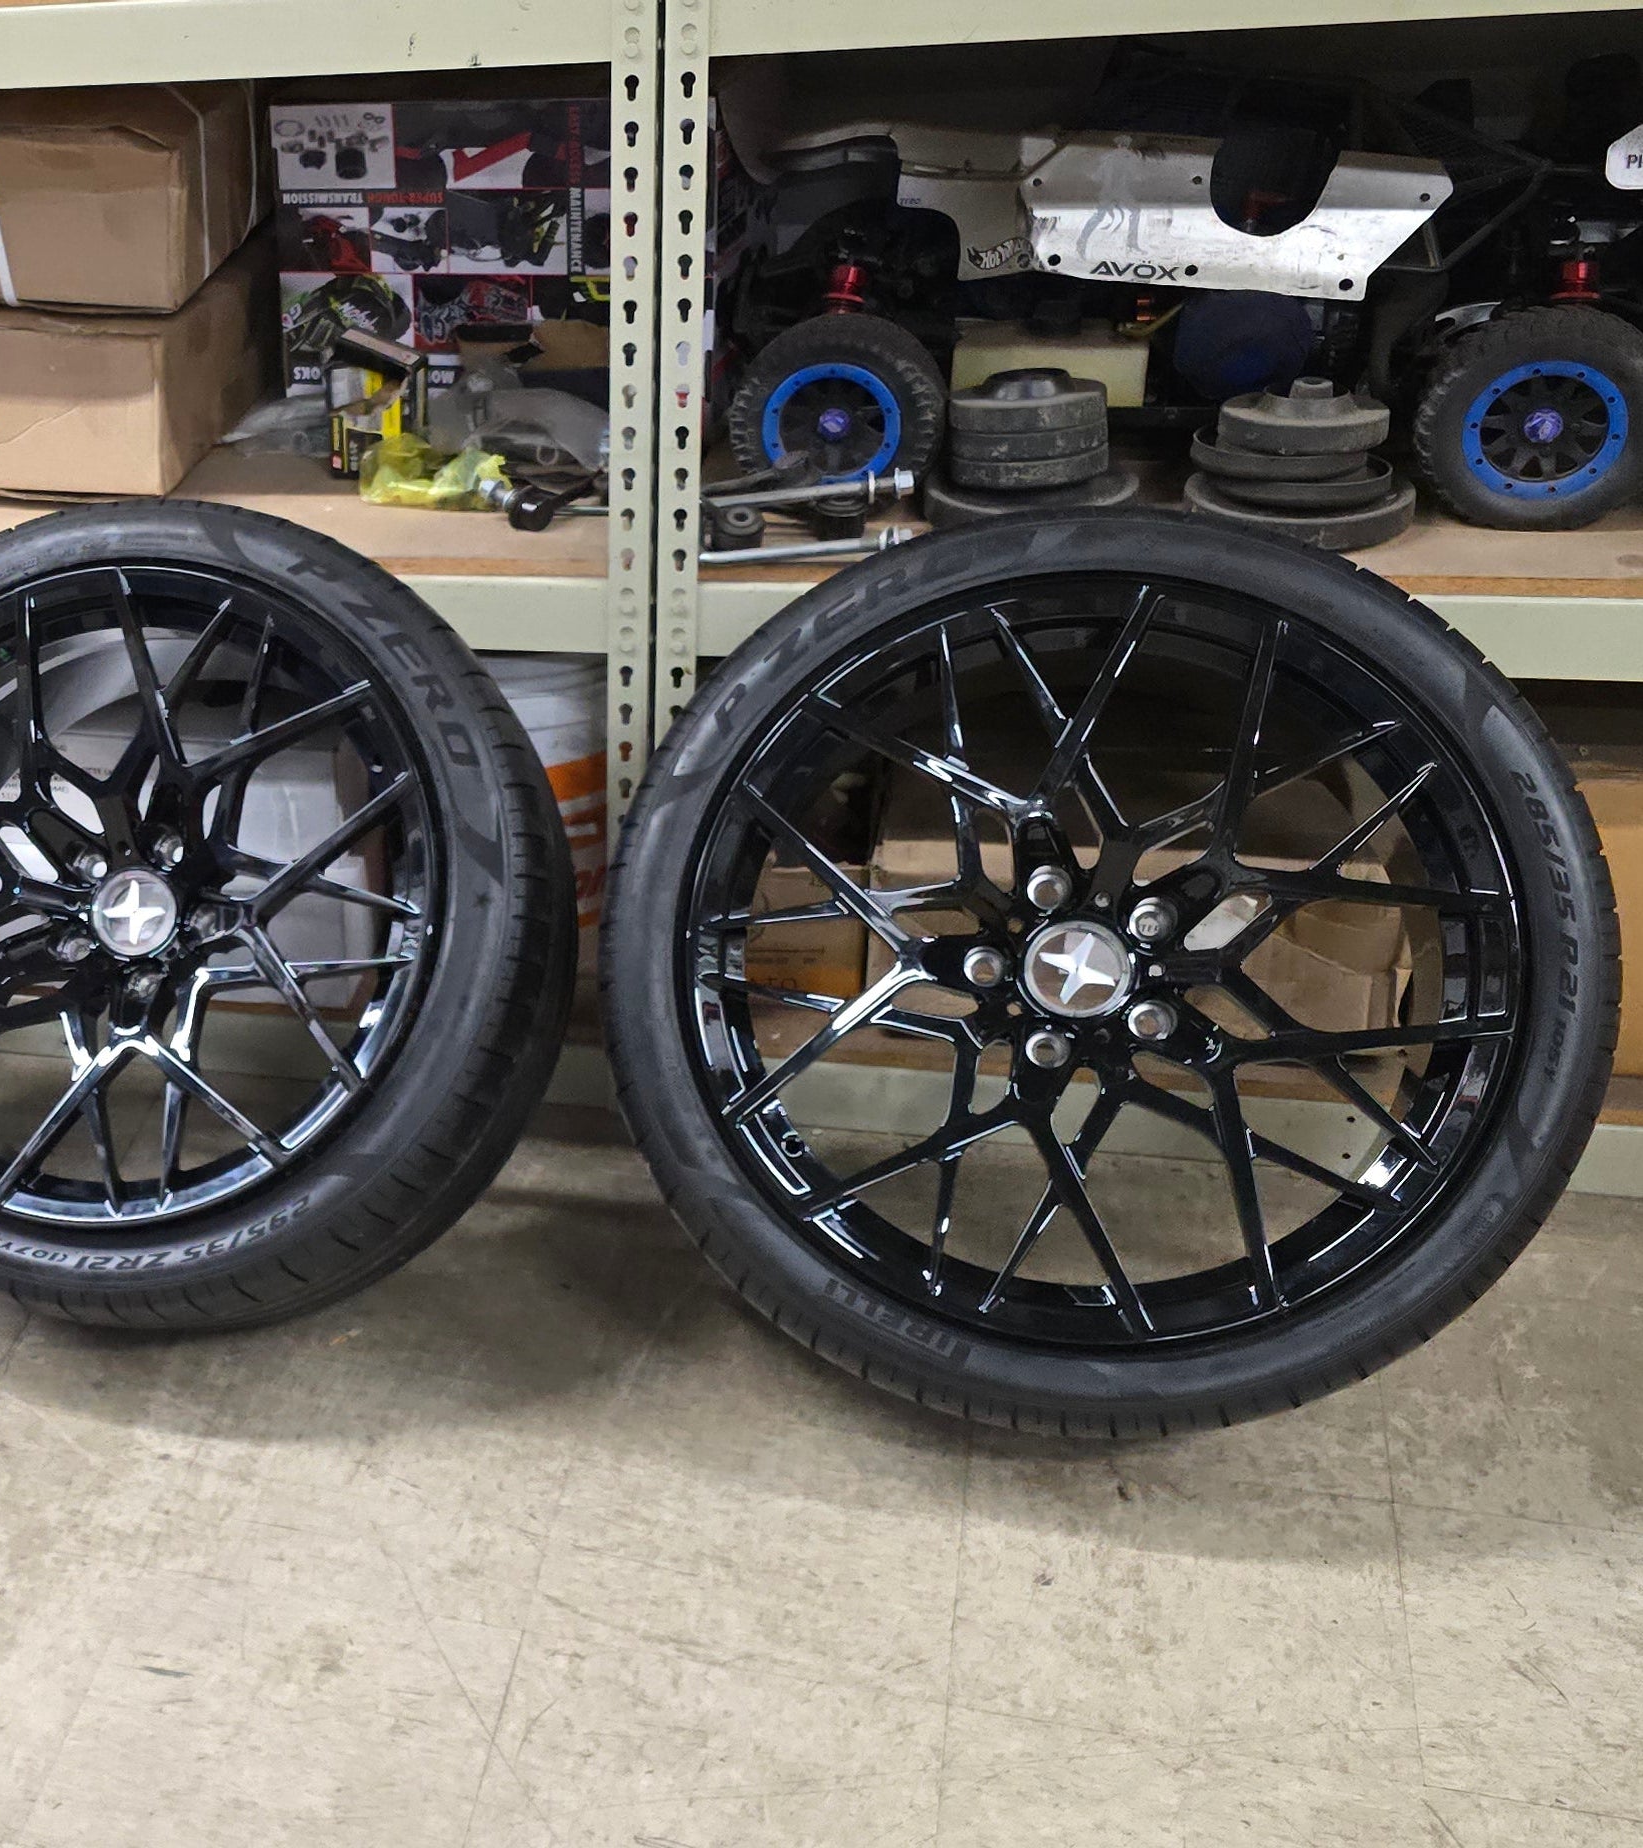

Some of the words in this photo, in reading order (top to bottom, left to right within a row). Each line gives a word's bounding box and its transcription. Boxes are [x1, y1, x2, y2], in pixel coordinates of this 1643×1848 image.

[283, 192, 364, 205] TRANSMISSION
[569, 187, 584, 274] MAINTENANCE
[1090, 260, 1181, 281] AVÖX
[287, 558, 345, 583] P
[340, 600, 481, 768] ZERO
[715, 683, 747, 734] P
[763, 552, 974, 683] ZERO
[1510, 771, 1577, 922] 285/35
[74, 1250, 171, 1271] ZR21
[182, 1197, 310, 1264] 295/35
